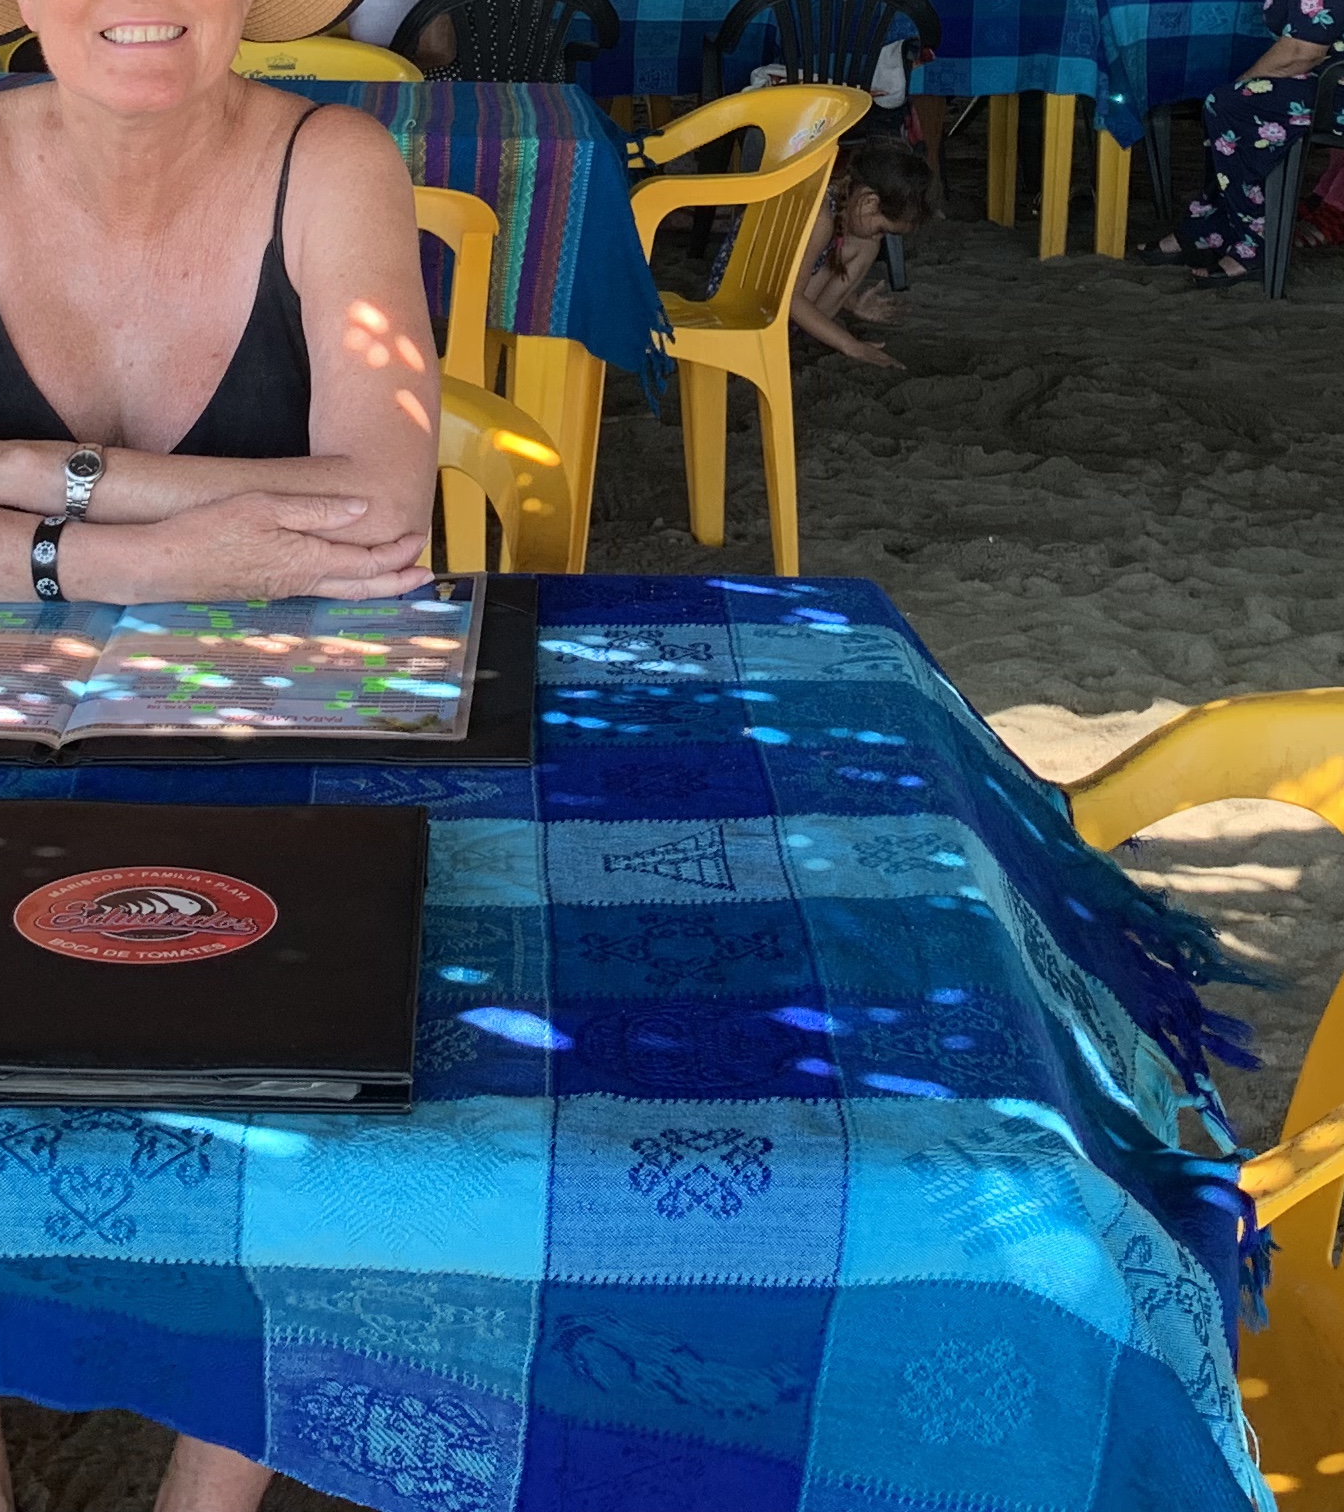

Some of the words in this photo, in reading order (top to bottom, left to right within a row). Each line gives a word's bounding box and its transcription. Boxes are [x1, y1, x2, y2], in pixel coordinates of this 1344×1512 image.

[48, 873, 124, 899] MARISCOS
[141, 871, 201, 883] FAMILIA
[213, 881, 252, 902] PLAYA
[35, 899, 260, 933] Eduardos
[48, 937, 99, 956] BOCA
[102, 948, 131, 959] DE
[136, 942, 228, 959] TOMATES
